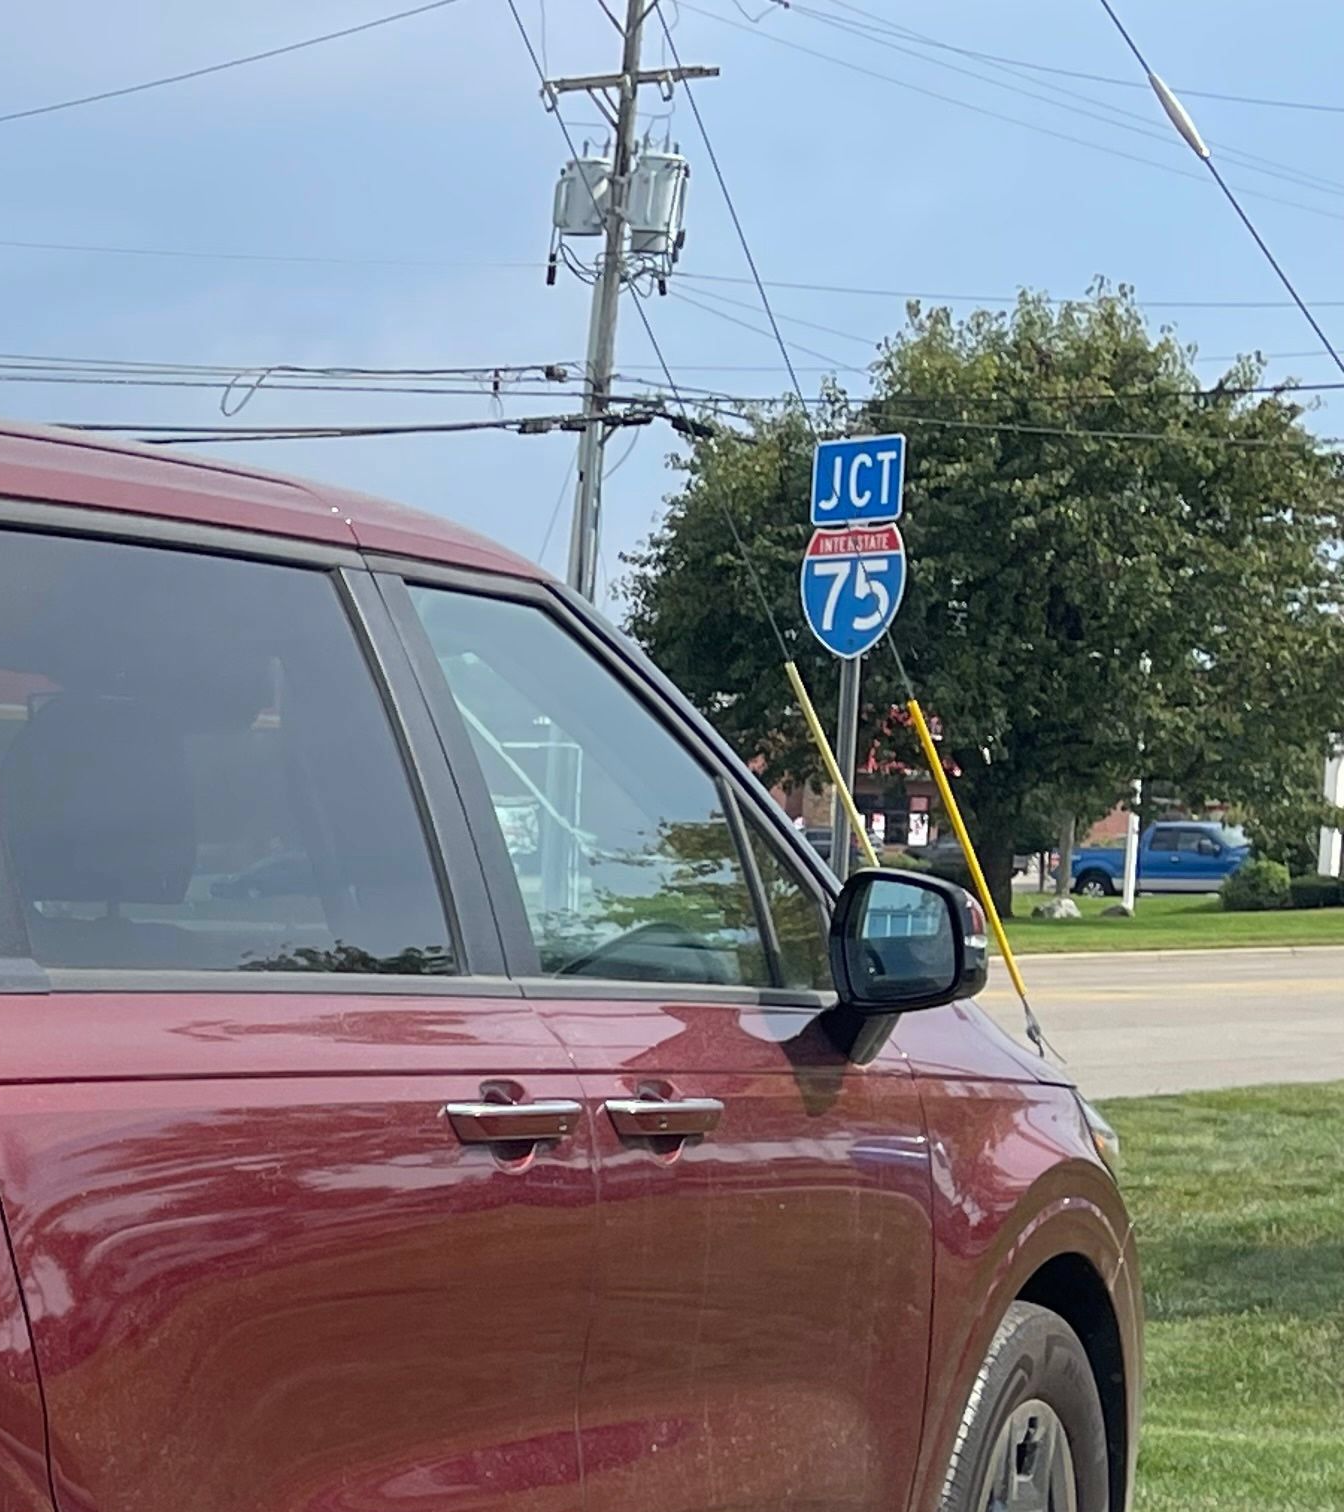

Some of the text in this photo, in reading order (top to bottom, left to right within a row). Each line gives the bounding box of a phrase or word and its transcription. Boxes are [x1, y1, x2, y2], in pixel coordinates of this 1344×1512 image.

[819, 451, 897, 510] JCT
[819, 533, 889, 553] INTERSTATE
[814, 559, 889, 631] 75
